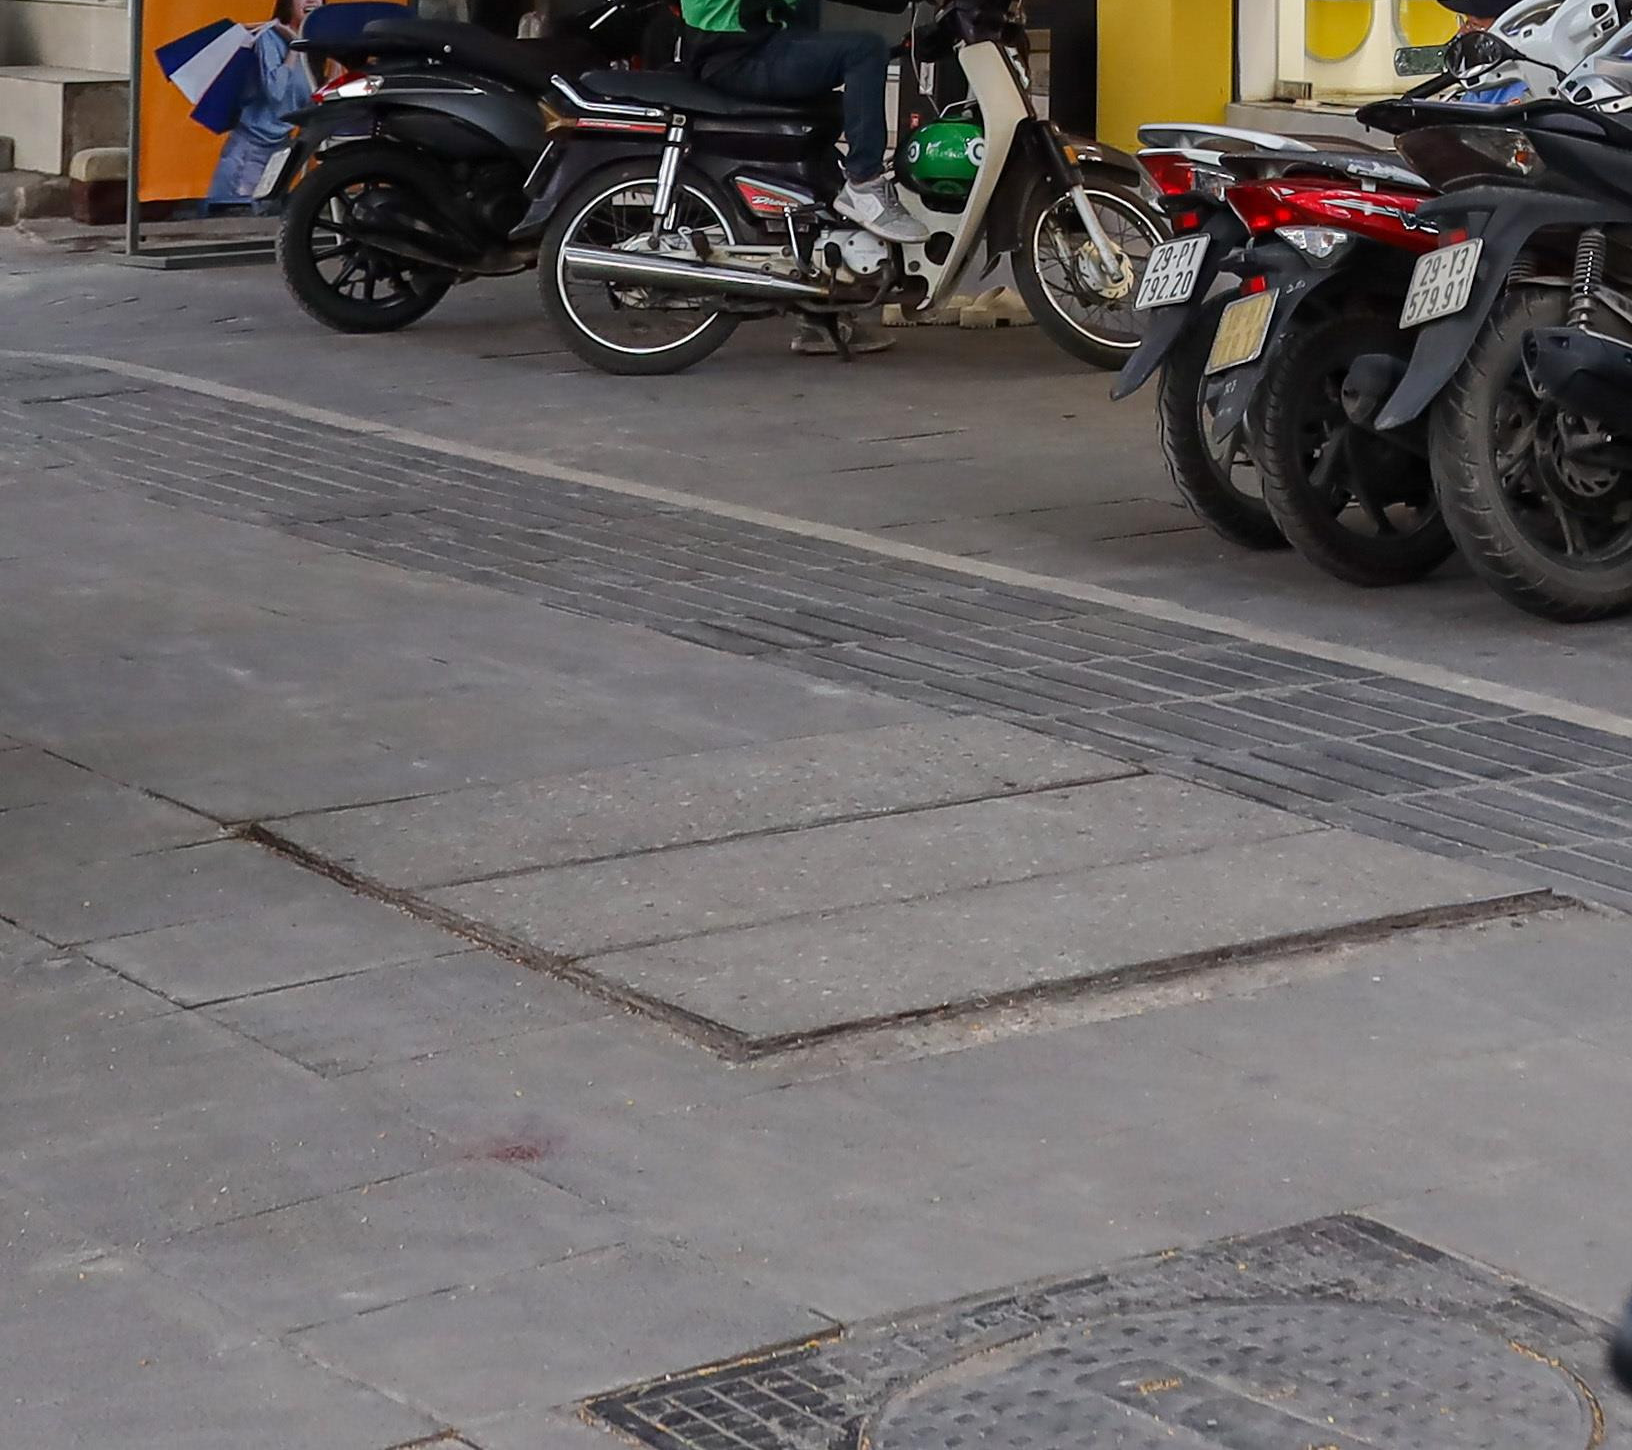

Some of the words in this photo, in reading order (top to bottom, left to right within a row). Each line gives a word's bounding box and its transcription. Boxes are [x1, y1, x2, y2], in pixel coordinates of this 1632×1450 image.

[1153, 241, 1199, 274] 29-P1
[1419, 247, 1470, 287] 29-Y3
[1144, 271, 1193, 307] 792.20
[1408, 281, 1466, 320] 579.91
